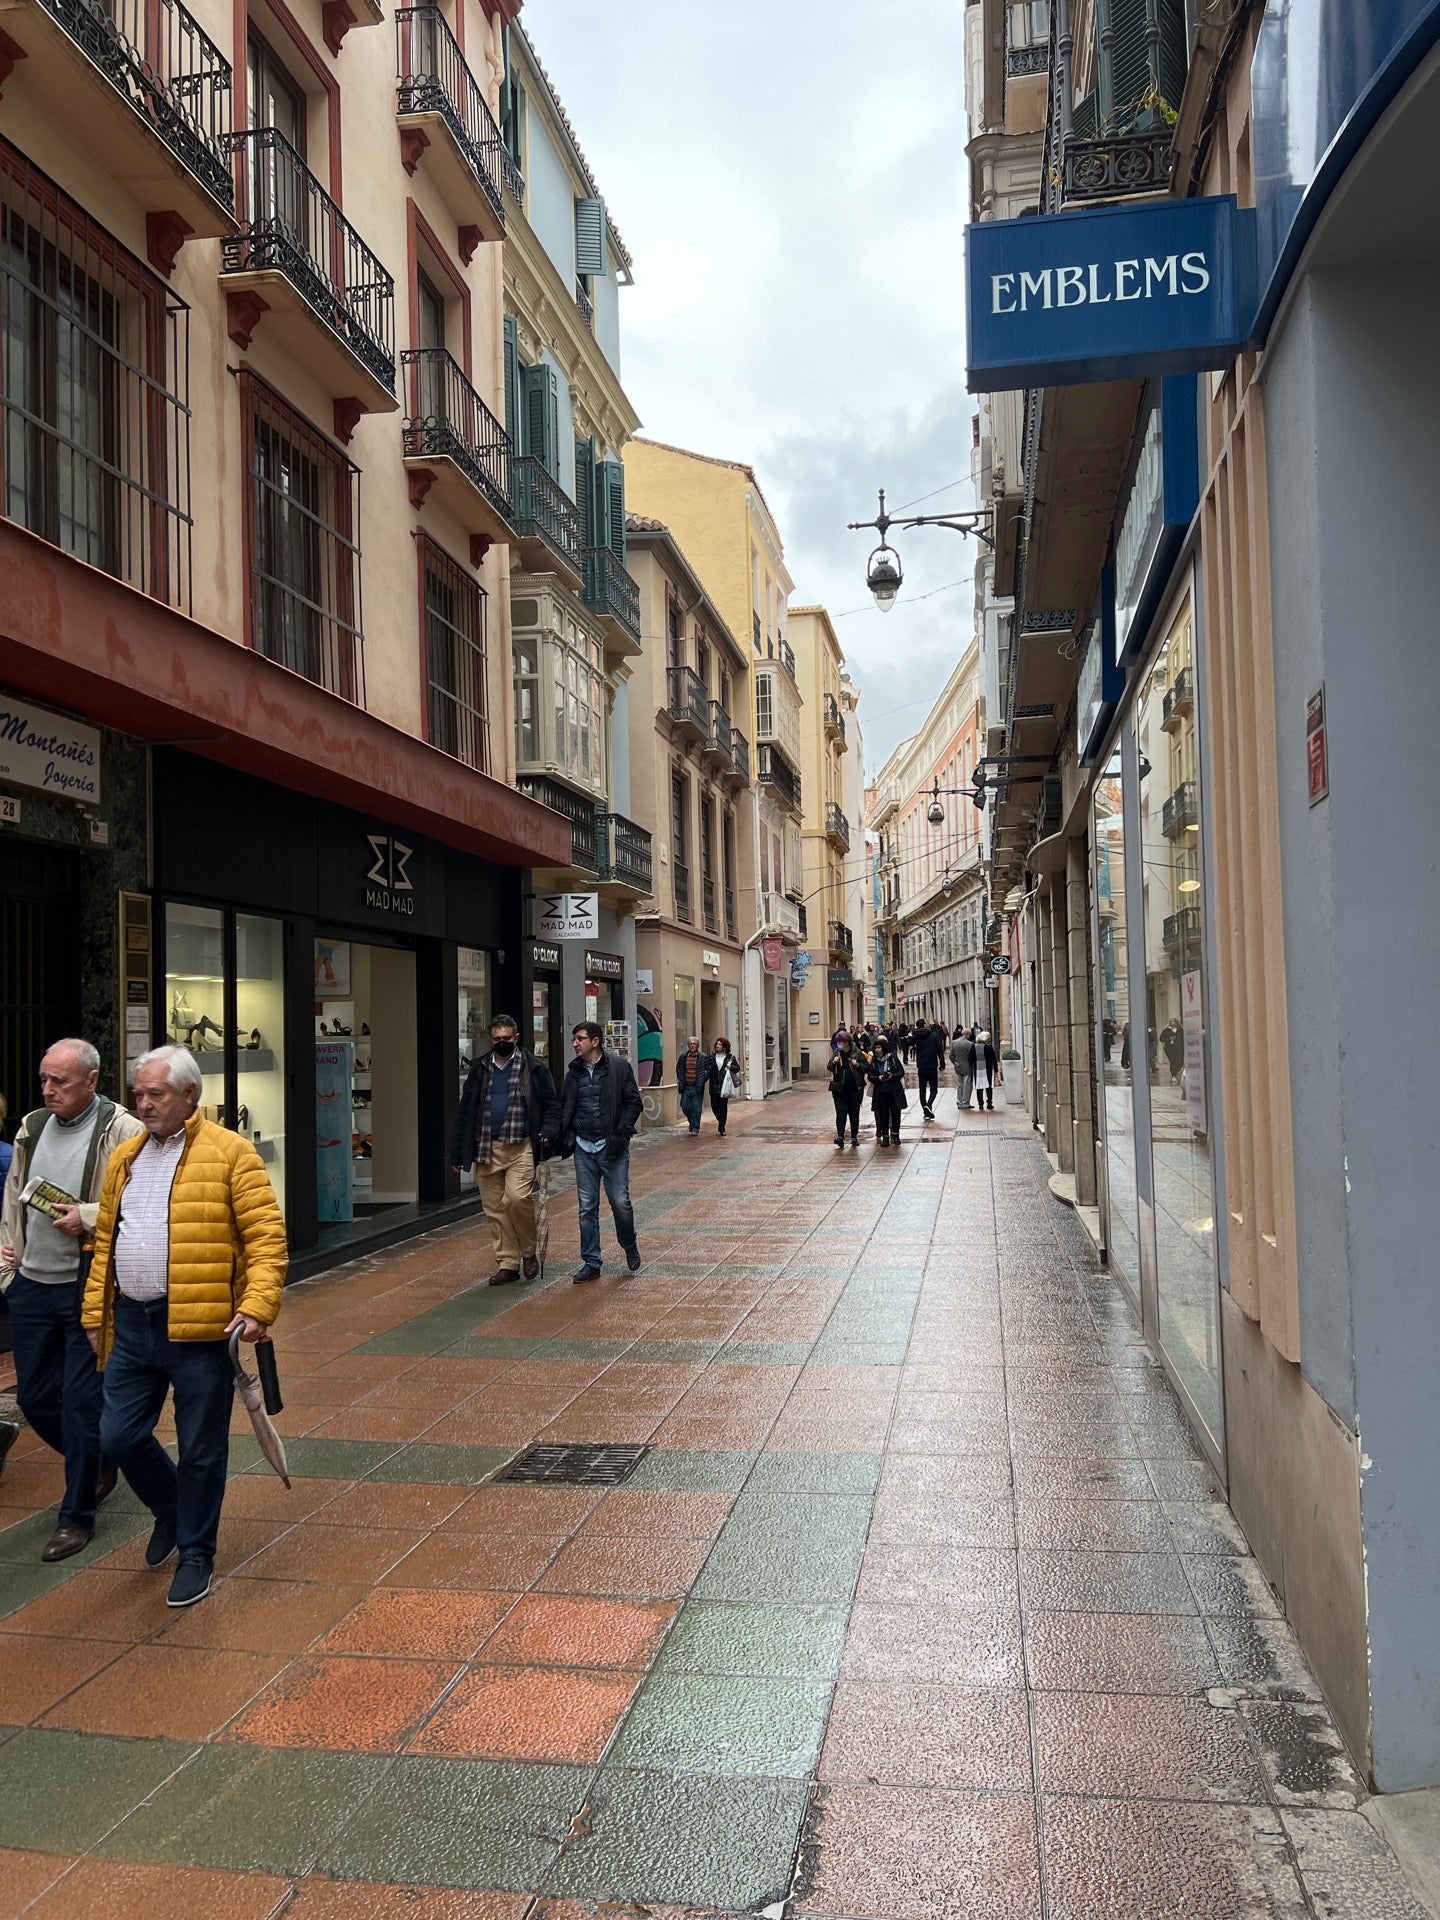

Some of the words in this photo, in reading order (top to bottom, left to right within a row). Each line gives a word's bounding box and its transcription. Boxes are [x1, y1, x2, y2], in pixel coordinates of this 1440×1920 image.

[990, 252, 1210, 314] EMBLEMS
[0, 712, 95, 766] Montañés
[43, 762, 95, 793] Joyería
[3, 801, 15, 817] 28
[366, 888, 390, 910] MAD
[392, 895, 414, 915] MAD
[541, 920, 565, 931] MAD
[568, 919, 593, 930] MAD
[591, 957, 603, 971] CORK
